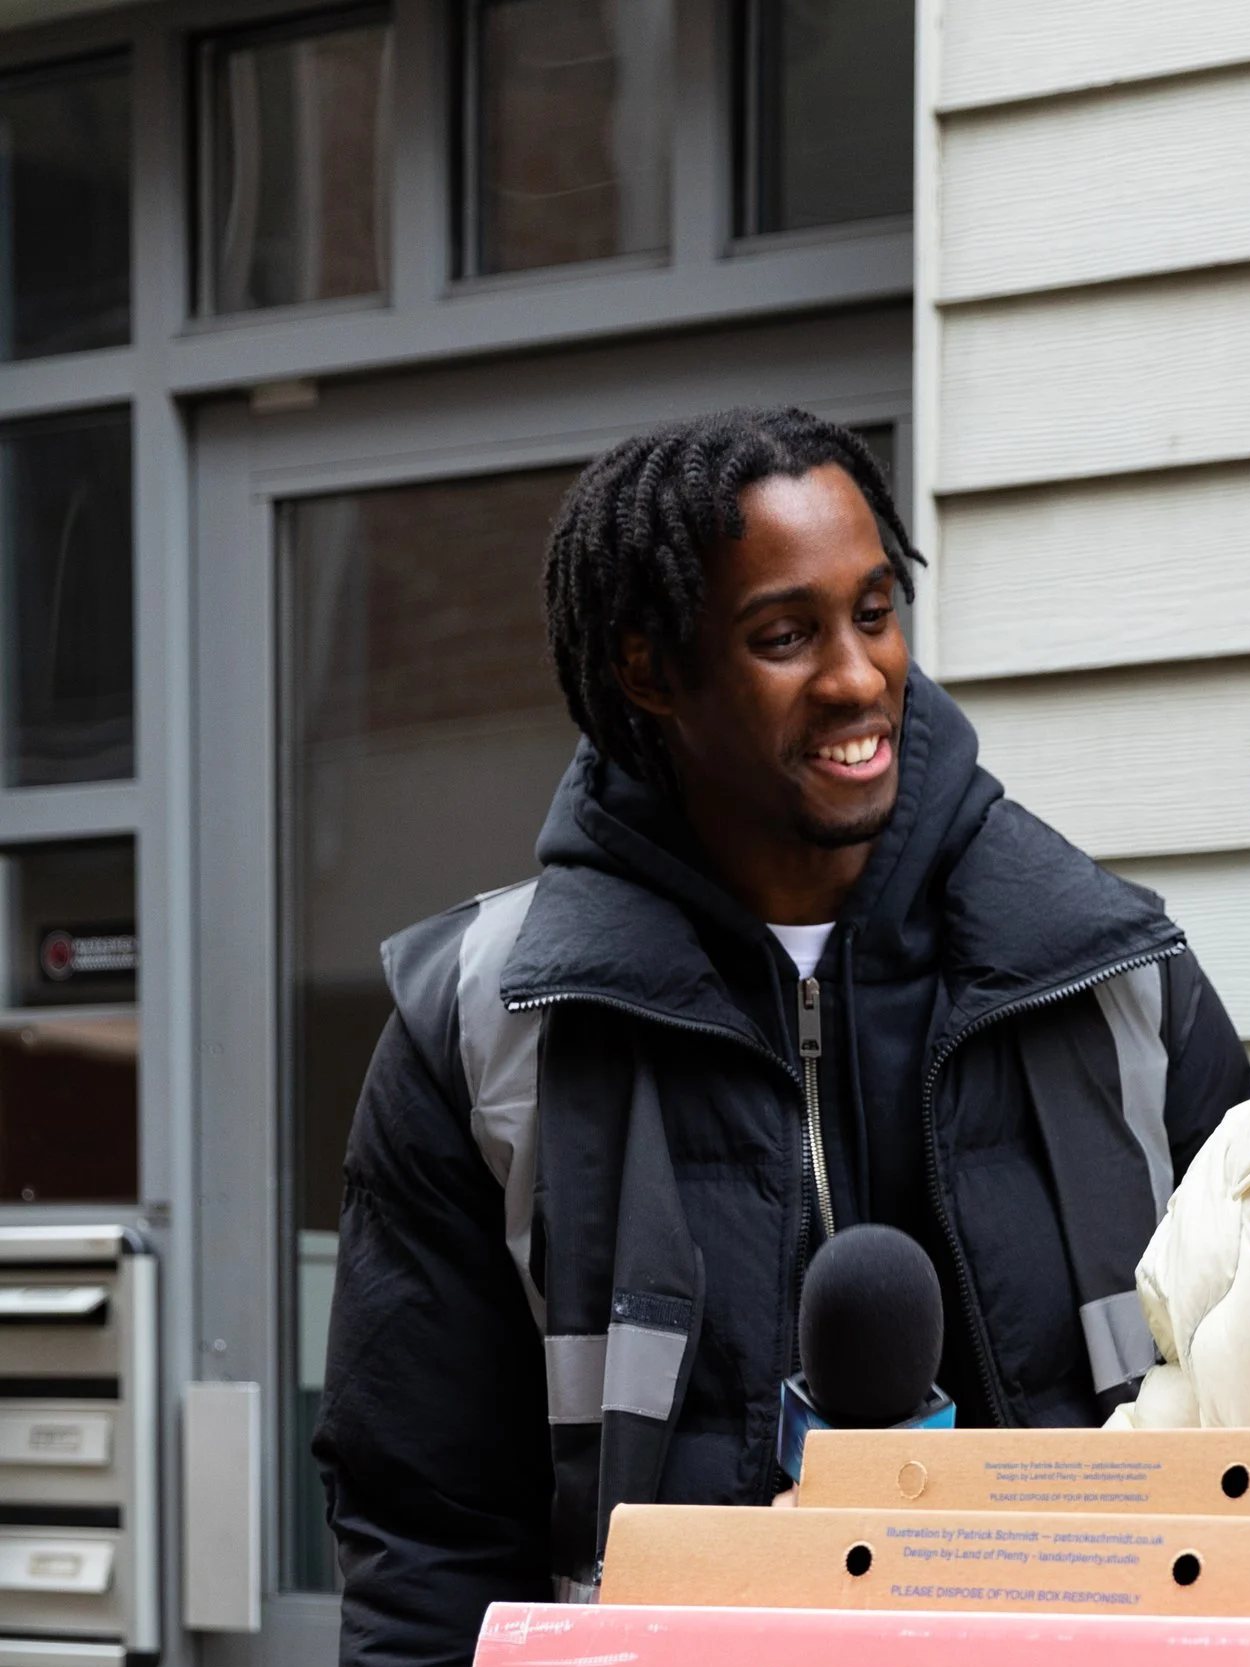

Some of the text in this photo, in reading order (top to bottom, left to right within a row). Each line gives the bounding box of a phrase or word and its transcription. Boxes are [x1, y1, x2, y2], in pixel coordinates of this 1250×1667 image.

[886, 1527, 940, 1539] Illustration
[942, 1529, 954, 1542] by
[957, 1528, 993, 1540] Patrick
[995, 1529, 1039, 1541] Schmidt
[903, 1546, 939, 1561] Design
[940, 1547, 953, 1561] by
[956, 1548, 982, 1560] Land
[984, 1548, 995, 1560] of
[997, 1549, 1030, 1564] Plenty
[891, 1584, 1142, 1605] PLEASE DISPOSE OF YOUR BOX RESPONSIBLY
